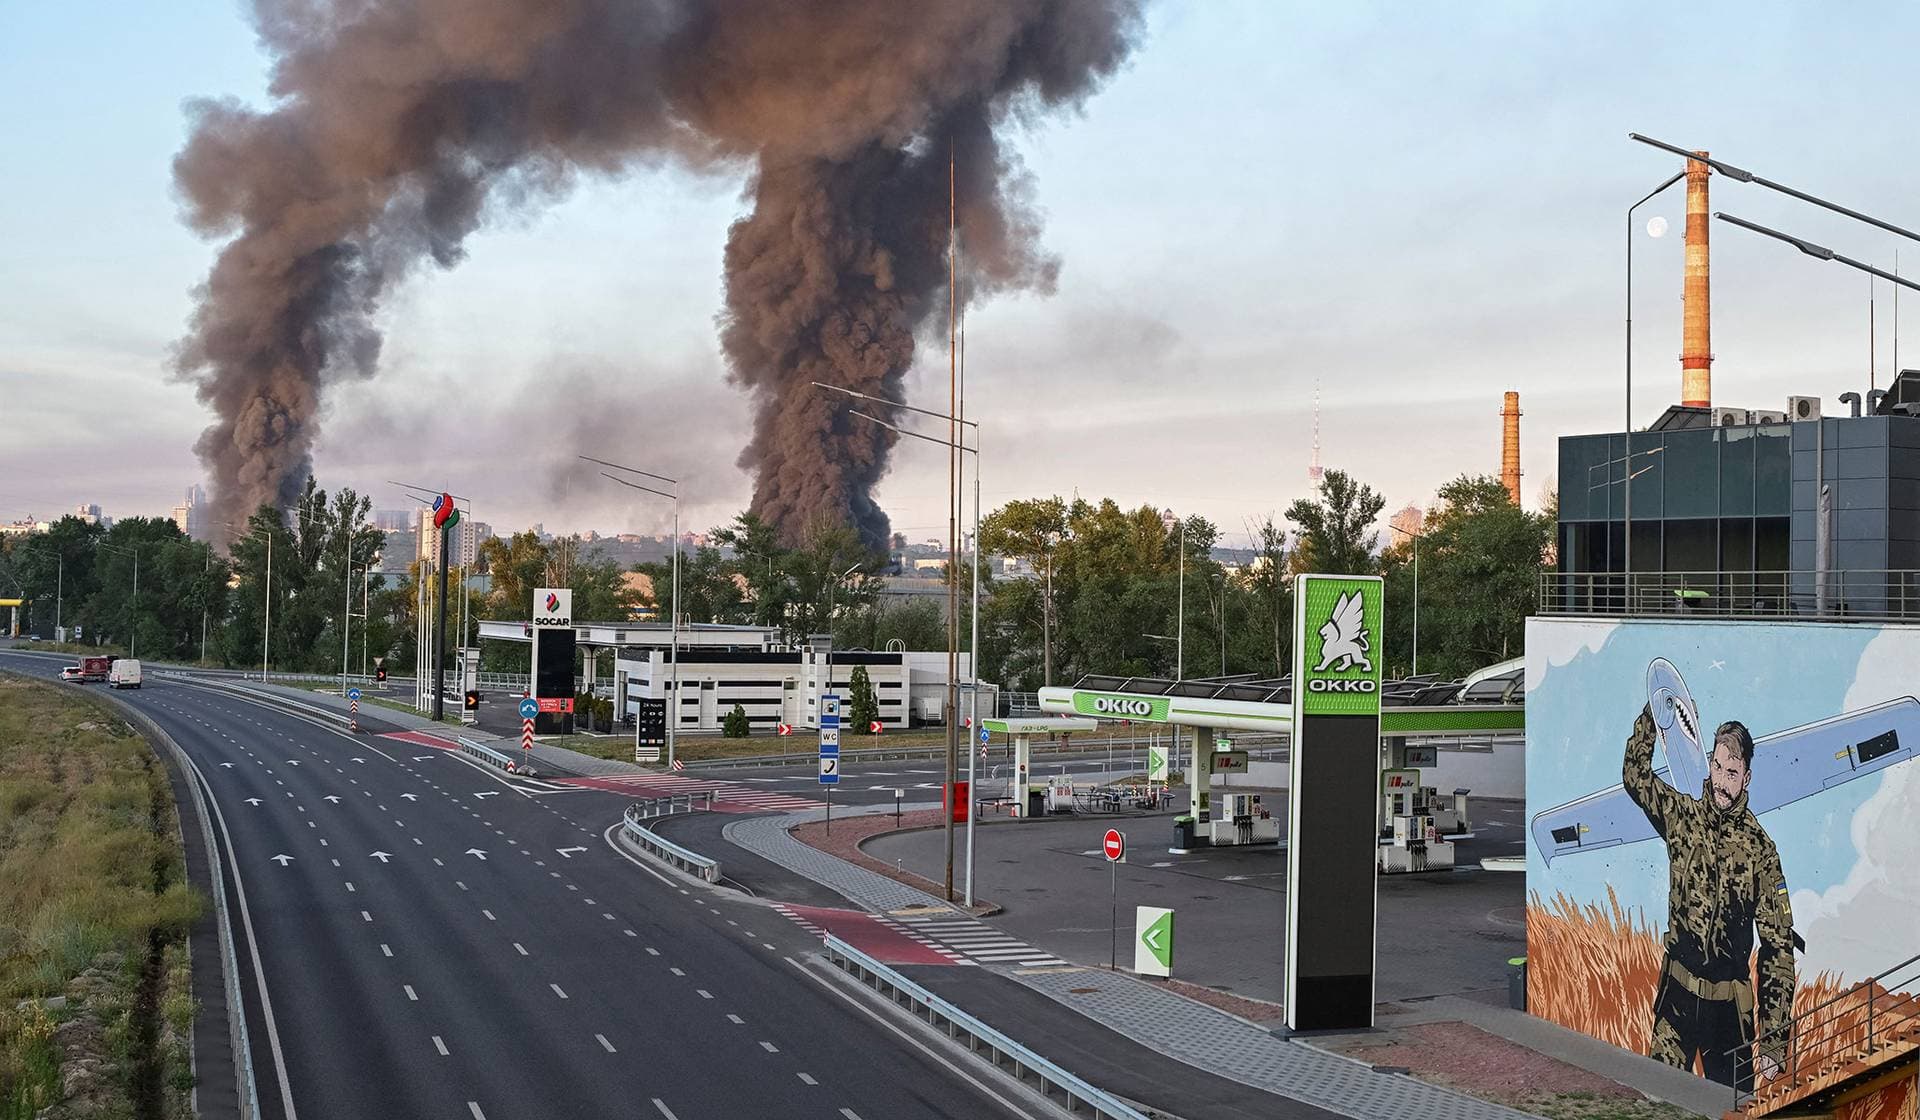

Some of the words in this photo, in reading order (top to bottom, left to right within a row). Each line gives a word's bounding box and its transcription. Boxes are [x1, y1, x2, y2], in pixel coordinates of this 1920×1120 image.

[535, 617, 570, 626] SOCAR
[1309, 679, 1376, 692] OKKO
[1094, 697, 1152, 716] OKKO
[823, 733, 837, 741] WC
[1200, 763, 1206, 771] 5
